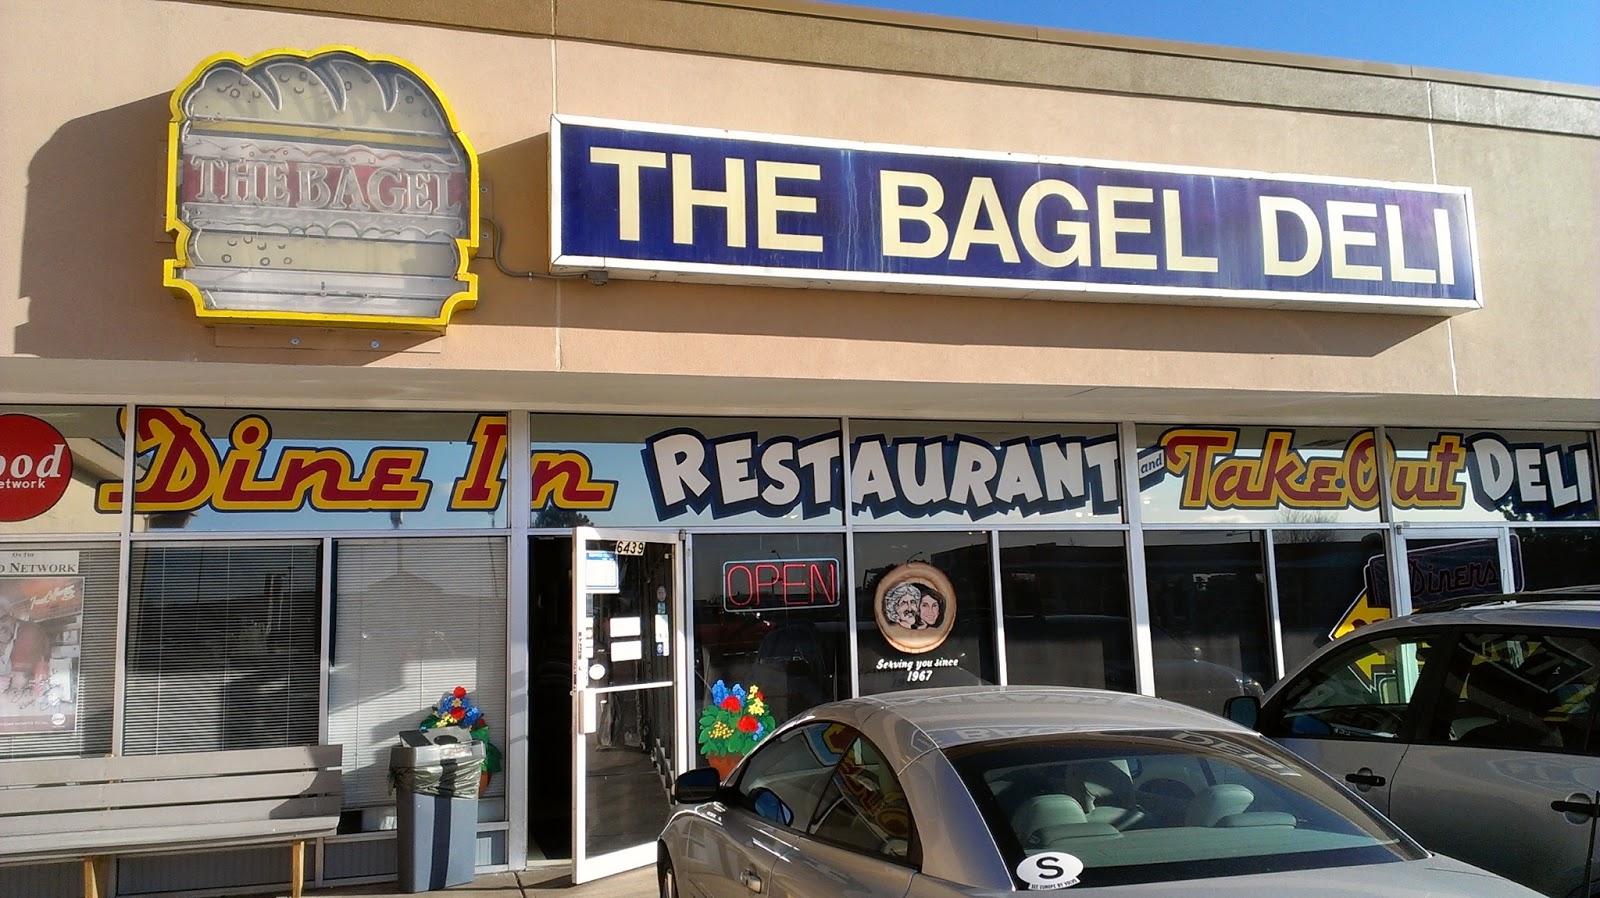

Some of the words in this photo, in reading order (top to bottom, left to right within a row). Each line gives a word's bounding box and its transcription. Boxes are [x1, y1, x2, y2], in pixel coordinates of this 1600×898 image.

[190, 154, 291, 206] THE
[296, 163, 463, 215] BAGEL
[589, 146, 824, 252] THE
[879, 169, 1219, 273] BAGEL
[1259, 195, 1456, 286] DELI
[96, 405, 432, 512] Dine
[447, 413, 617, 511] In
[644, 429, 1121, 518] RESTAURANT
[1139, 451, 1165, 476] and
[1466, 432, 1596, 513] DELI
[616, 541, 645, 554] 6439
[9, 563, 76, 573] NETWORK
[726, 562, 836, 605] OPEN
[876, 658, 913, 671] Serving
[915, 660, 932, 670] you
[934, 657, 959, 667] since
[907, 670, 933, 682] 1967
[1036, 856, 1064, 879] S
